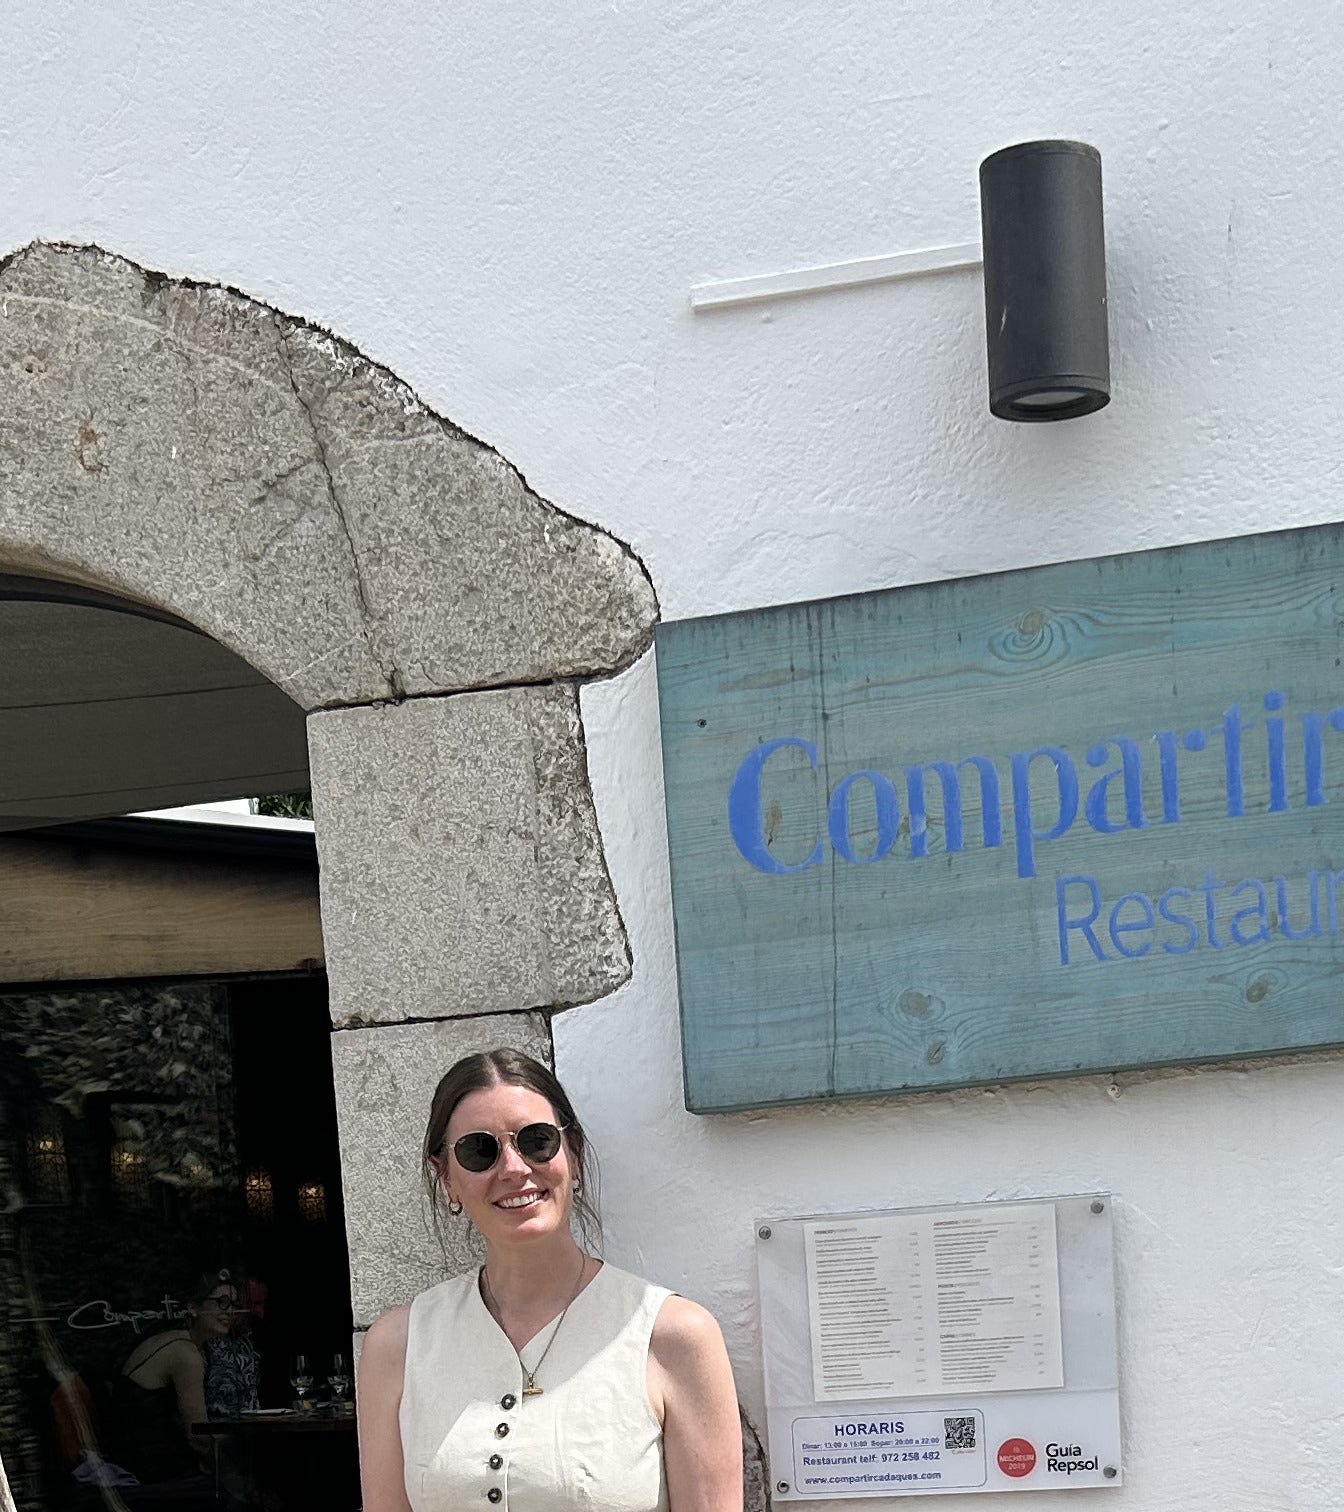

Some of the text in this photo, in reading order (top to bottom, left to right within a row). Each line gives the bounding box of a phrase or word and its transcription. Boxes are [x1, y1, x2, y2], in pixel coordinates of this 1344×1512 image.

[834, 1421, 905, 1436] HORARIS
[1045, 1442, 1082, 1458] Guía
[803, 1455, 858, 1466] Restaurant
[881, 1452, 899, 1463] 972
[922, 1451, 941, 1461] 482
[1047, 1455, 1099, 1475] Repsol
